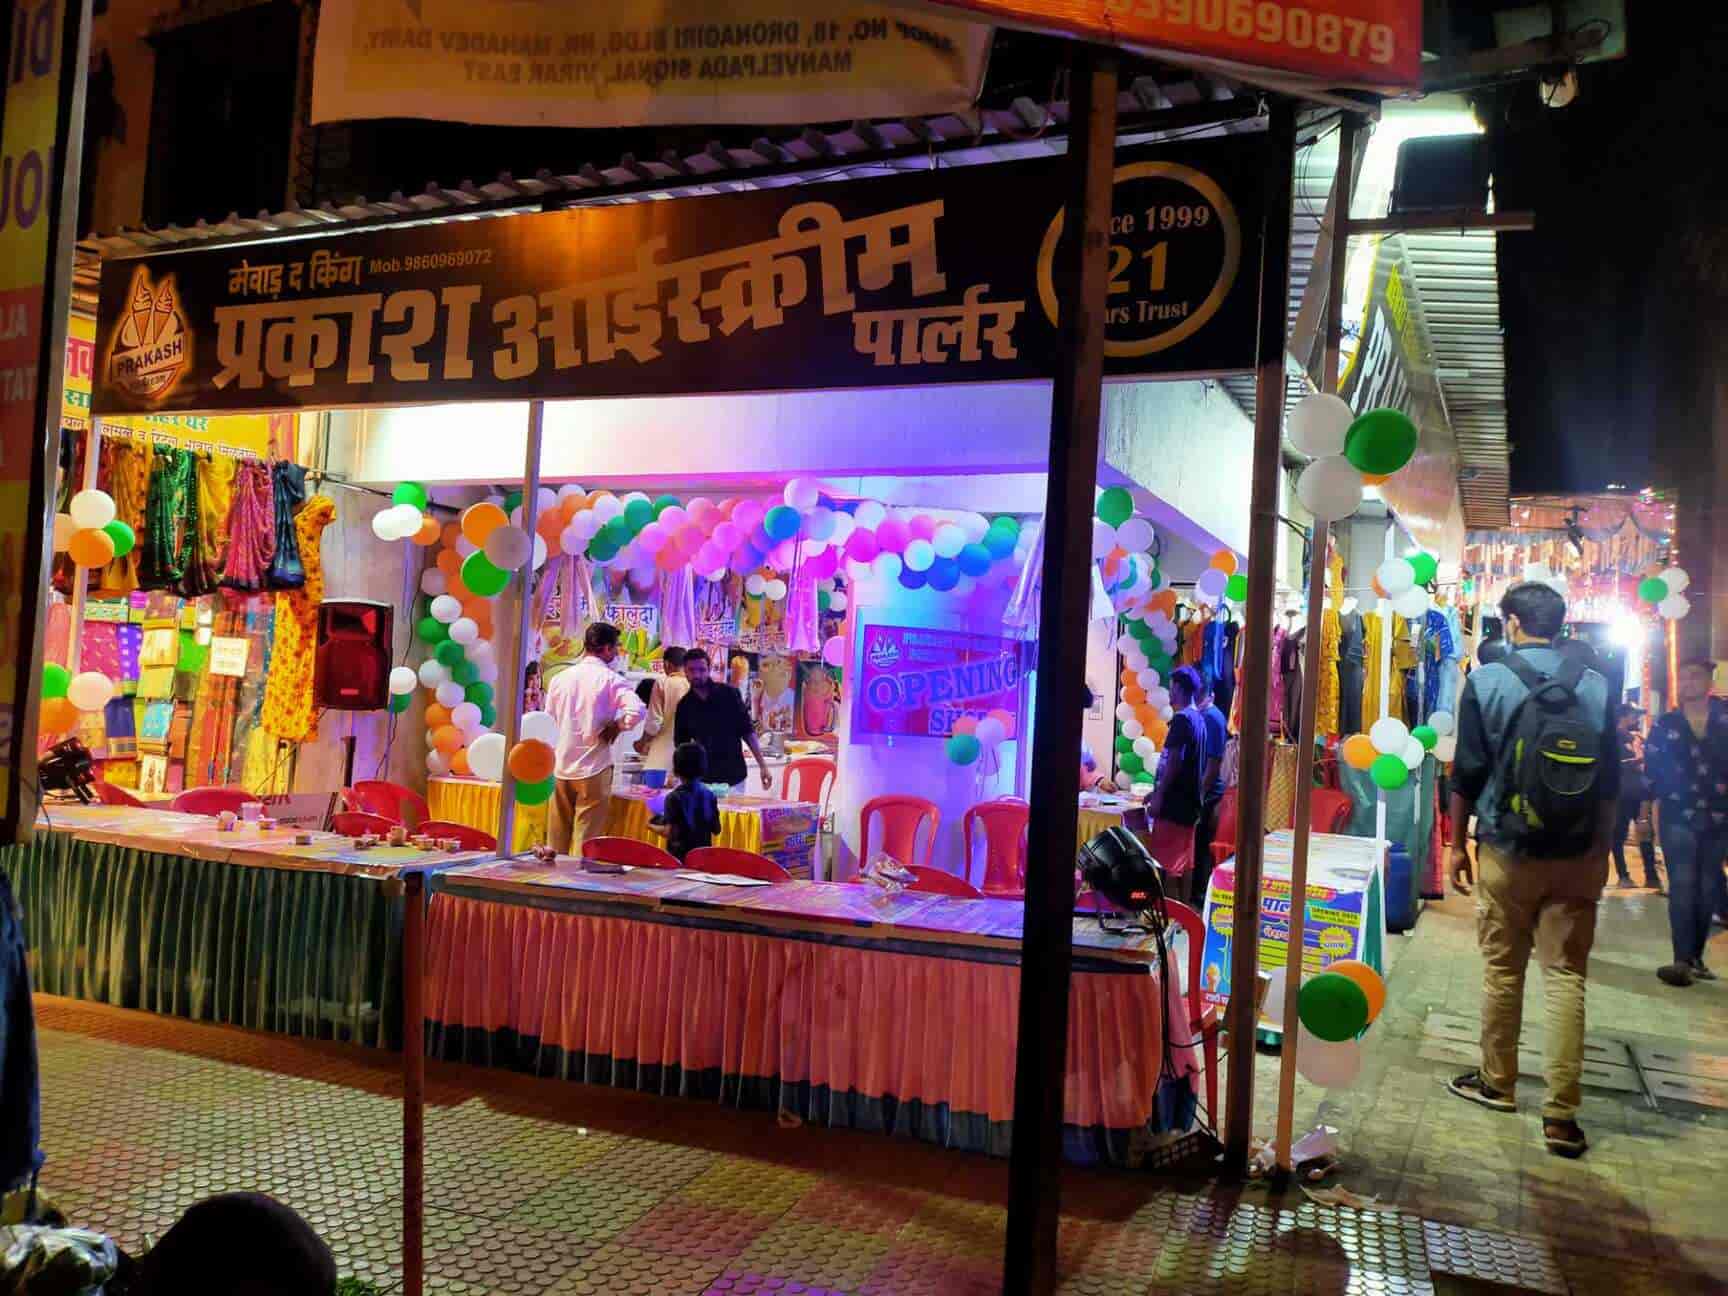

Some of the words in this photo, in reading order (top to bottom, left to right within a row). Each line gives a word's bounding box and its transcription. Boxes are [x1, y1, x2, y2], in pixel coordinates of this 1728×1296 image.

[1145, 206, 1210, 232] 1999
[1137, 300, 1189, 323] Trust
[211, 284, 482, 390] प्रकाश
[852, 283, 1026, 367] पार्लर
[117, 338, 183, 374] PRAKASH
